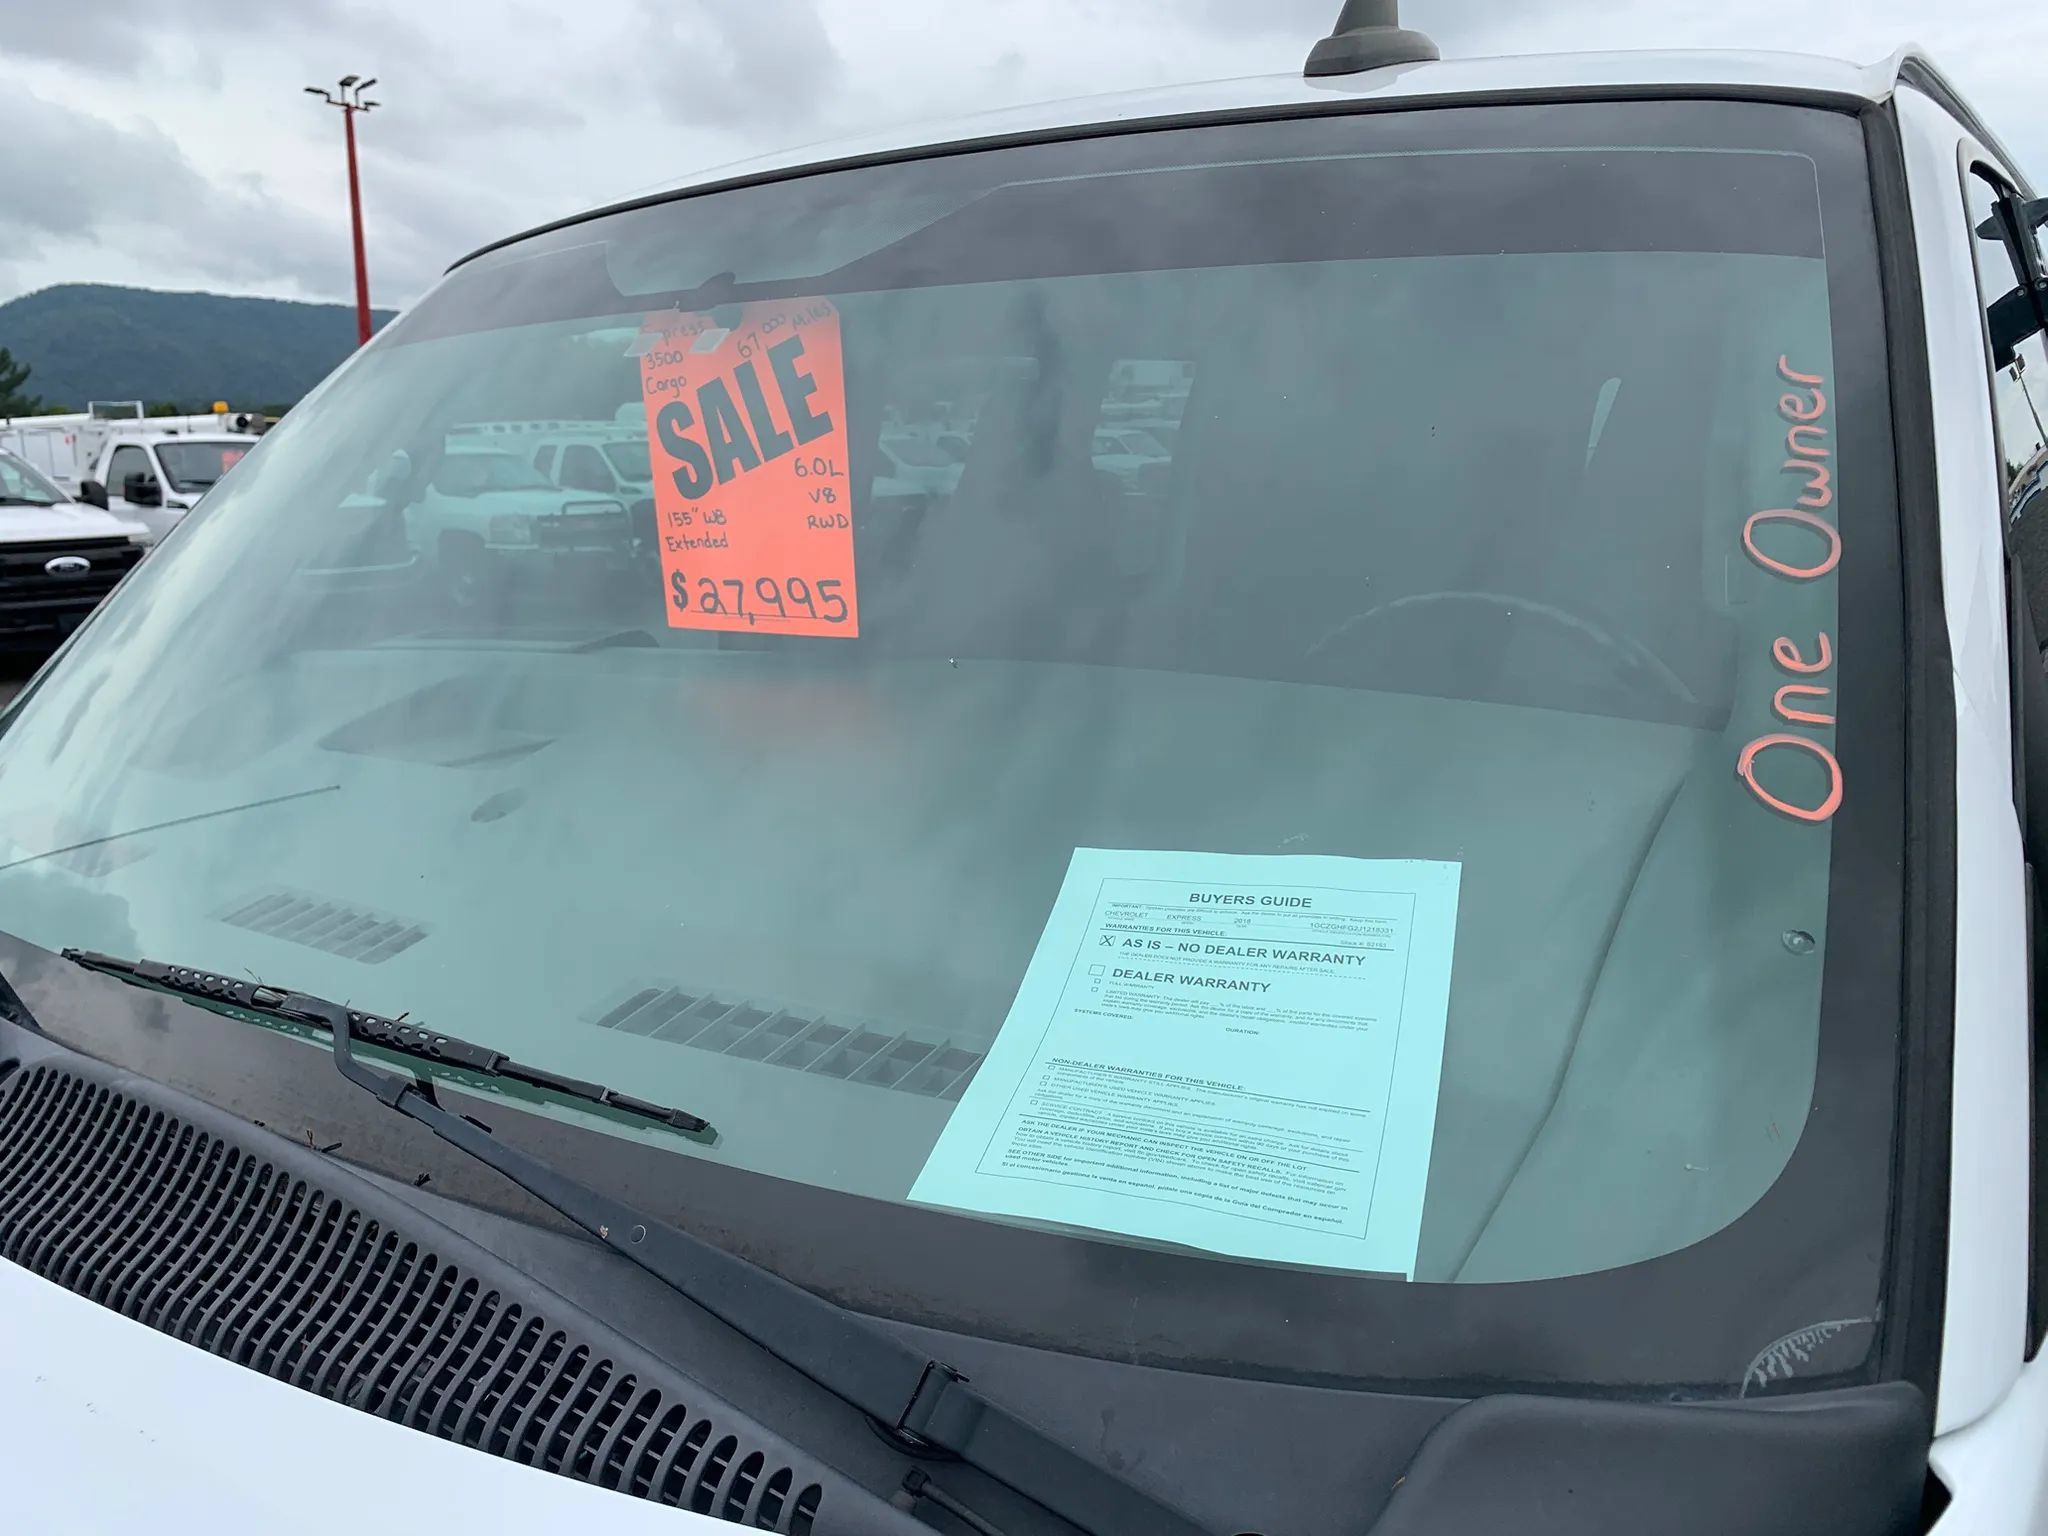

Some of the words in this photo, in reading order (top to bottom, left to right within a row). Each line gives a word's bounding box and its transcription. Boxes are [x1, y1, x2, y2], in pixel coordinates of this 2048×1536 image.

[646, 350, 684, 370] 3500
[645, 374, 688, 398] Cargo
[656, 334, 834, 500] SALE
[794, 457, 844, 478] 6.0L
[1743, 354, 1842, 578] Owner
[808, 487, 837, 504] V8
[807, 513, 849, 530] RWD
[665, 531, 729, 552] Extended
[1737, 632, 1843, 821] One
[1189, 893, 1255, 906] BUYERS
[1260, 896, 1313, 908] GUIDE
[1104, 923, 1154, 931] WARRANTIES
[1122, 938, 1143, 948] AS
[1147, 940, 1161, 950] IS
[1178, 943, 1200, 953] NO
[1204, 945, 1268, 959] DEALER
[1272, 949, 1366, 966] WARRANTY
[1112, 968, 1175, 983] DEALER
[1179, 975, 1271, 993] WARRANTY
[1050, 1057, 1105, 1069] NON-DEALER
[1105, 1064, 1164, 1078] WARRANTIES
[1050, 1131, 1077, 1139] VEHICLE
[1079, 1136, 1108, 1144] HISTORY
[1109, 1140, 1137, 1148] REPORT
[1218, 1159, 1245, 1167] SAFETY
[1105, 1132, 1141, 1141] MECHANIC
[1158, 1141, 1188, 1149] INSPECT
[1204, 1148, 1235, 1157] VEHICLE
[1073, 1158, 1105, 1167] important
[1105, 1163, 1138, 1172] additional
[1180, 1175, 1212, 1185] including
[1239, 1187, 1258, 1195] major
